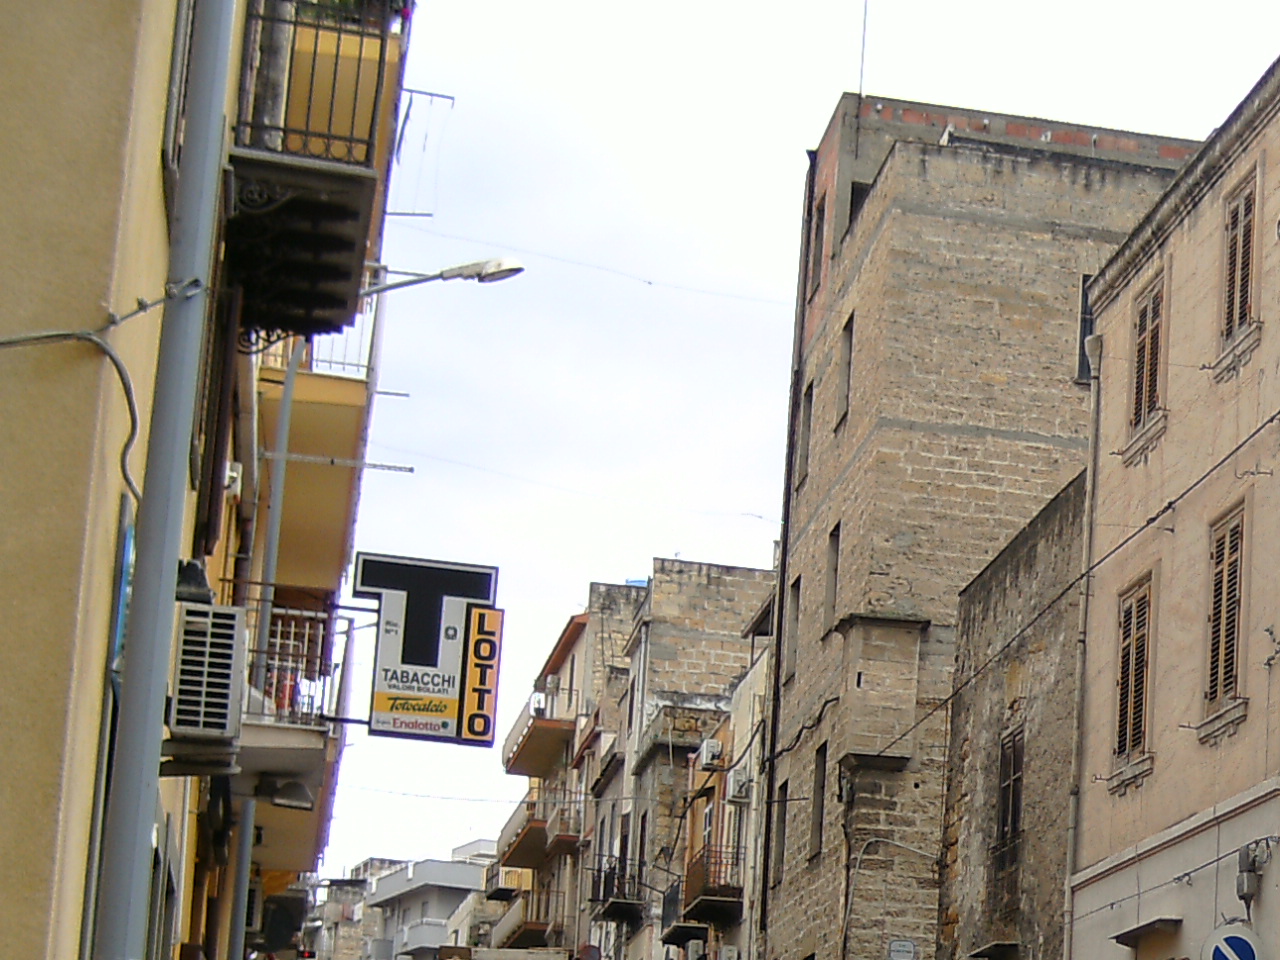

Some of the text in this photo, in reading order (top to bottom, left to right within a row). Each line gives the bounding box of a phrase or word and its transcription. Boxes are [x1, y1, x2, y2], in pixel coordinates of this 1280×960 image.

[382, 668, 456, 688] TABACCHI
[468, 613, 498, 736] LOTTO
[387, 684, 415, 692] VALORI
[387, 697, 449, 713] Totocalcio
[392, 718, 441, 731] Enalotto
